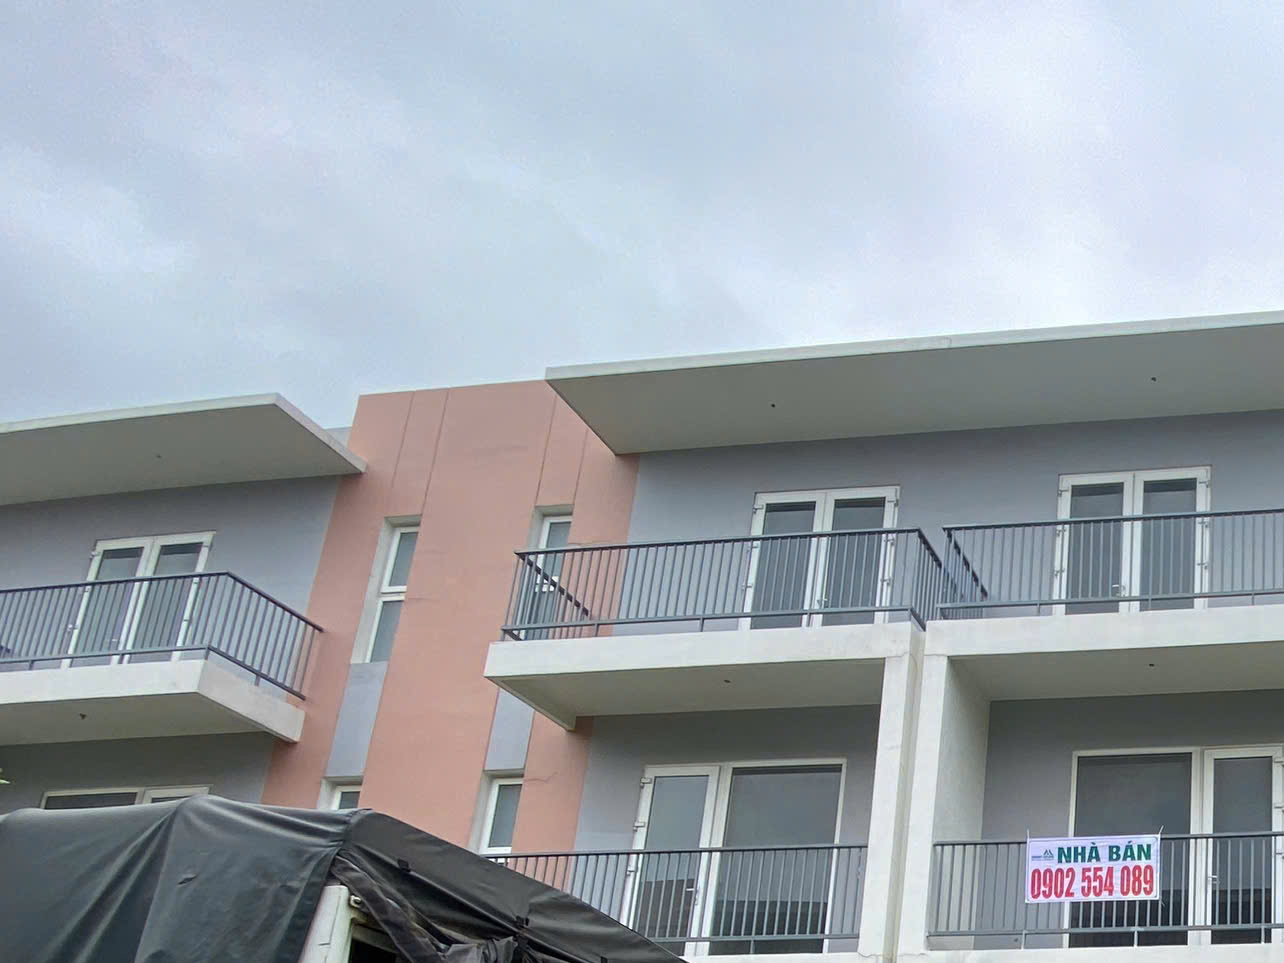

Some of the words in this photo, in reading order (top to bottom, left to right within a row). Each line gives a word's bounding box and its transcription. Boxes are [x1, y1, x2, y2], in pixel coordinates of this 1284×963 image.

[1057, 842, 1101, 864] NHÀ
[1108, 840, 1151, 861] BÁN
[1031, 868, 1075, 899] 0902
[1081, 866, 1114, 897] 554
[1120, 865, 1154, 896] 089
